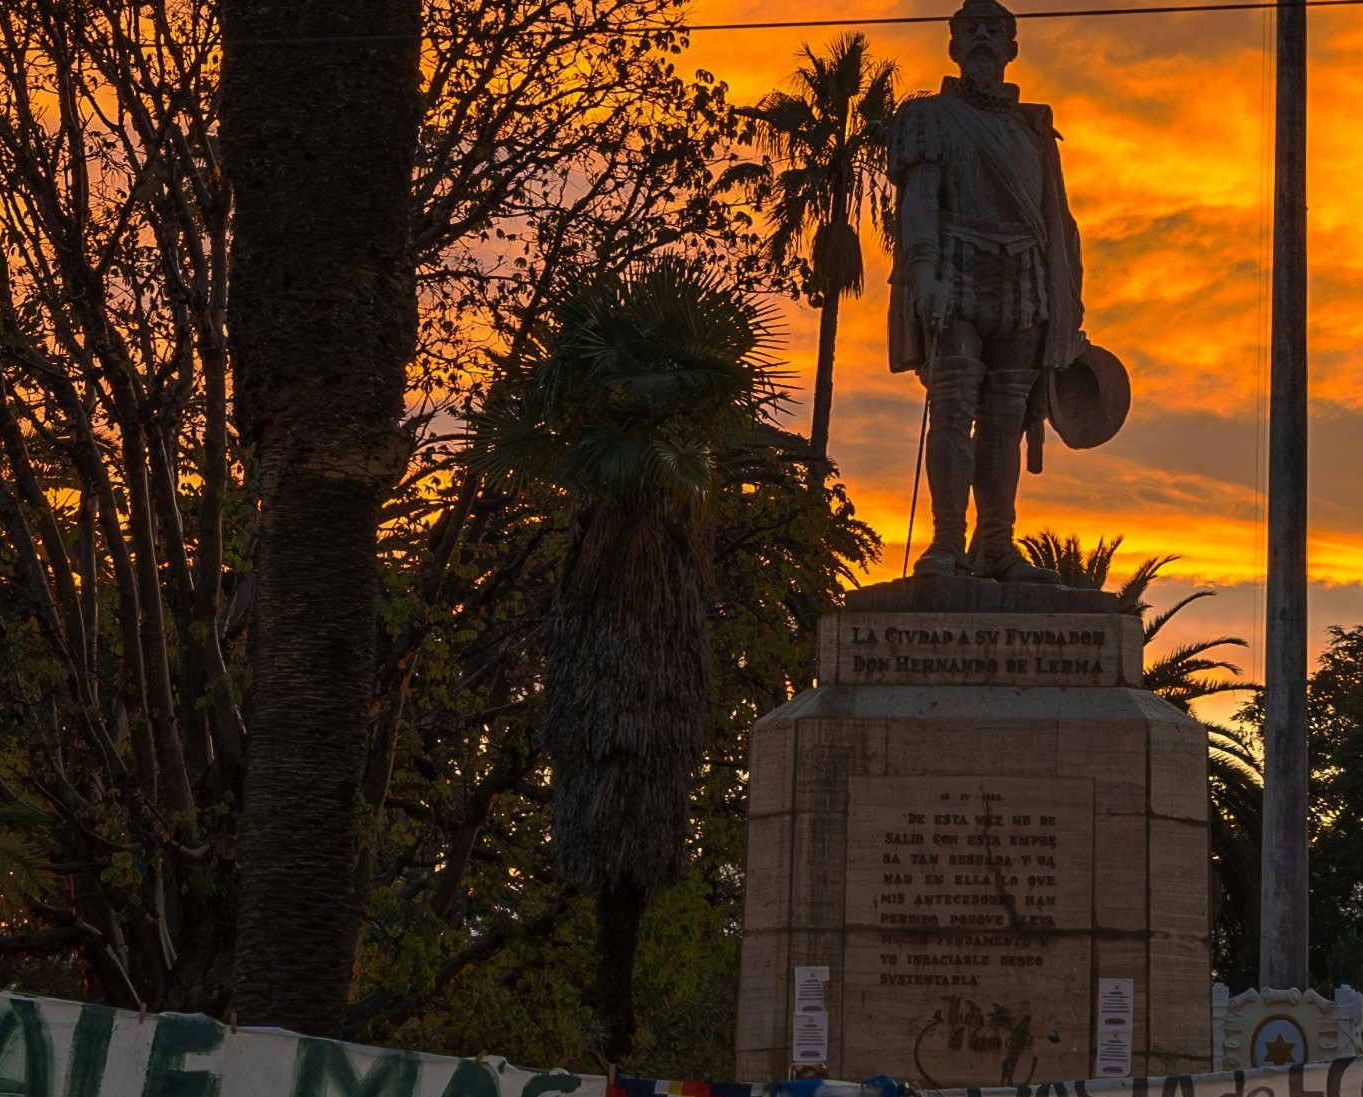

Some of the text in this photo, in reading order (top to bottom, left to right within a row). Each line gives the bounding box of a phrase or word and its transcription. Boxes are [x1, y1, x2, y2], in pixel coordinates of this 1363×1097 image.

[852, 627, 879, 645] LA
[957, 630, 971, 646] A
[1004, 628, 1106, 647] FVNDADOR
[853, 655, 1105, 675] DON HERNANDO DE LERMA
[933, 813, 969, 826] ESTA
[1039, 814, 1057, 827] DE
[884, 832, 925, 845] SALIR
[932, 833, 960, 846] CON
[966, 834, 1002, 847] ESTA
[881, 853, 902, 865] SA
[909, 853, 940, 866] TAN
[883, 873, 913, 886] NAR
[924, 874, 944, 886] EN
[879, 953, 1045, 967] YO INSACIABLE DESEO
